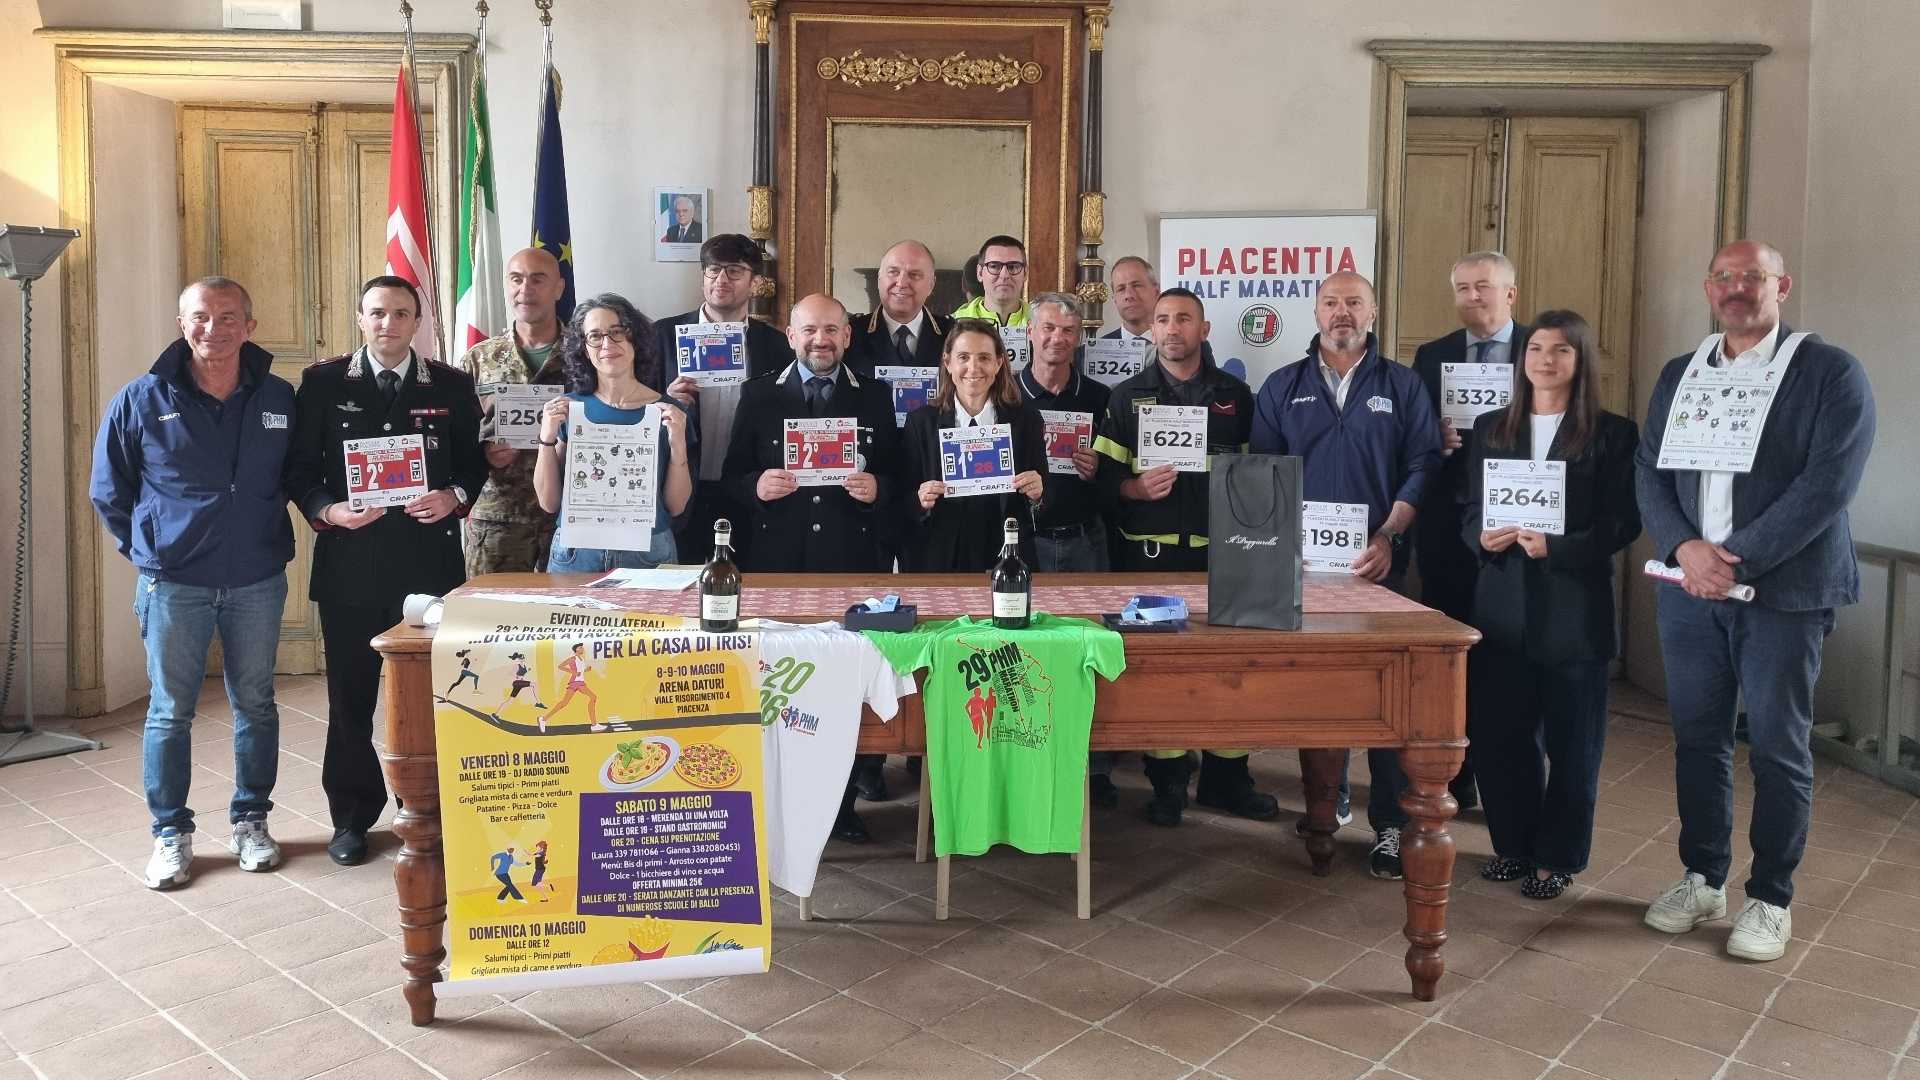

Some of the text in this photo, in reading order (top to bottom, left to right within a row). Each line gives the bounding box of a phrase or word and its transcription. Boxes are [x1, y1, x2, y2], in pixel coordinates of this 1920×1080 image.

[1178, 246, 1357, 275] PLACENTIA
[1096, 360, 1133, 376] 324
[1457, 388, 1497, 406] 332
[158, 412, 181, 422] CRAFT
[273, 414, 288, 426] PHM
[1153, 430, 1193, 448] 622
[980, 483, 1006, 491] CRAFT
[389, 494, 416, 502] CRAFT
[1499, 487, 1549, 507] 264
[1523, 521, 1552, 529] CRAFT
[1310, 528, 1350, 548] 198
[550, 612, 665, 629] EVENTI COLLATERALI
[593, 634, 752, 659] PER LA CASA DI IRIS!
[987, 641, 1023, 674] PHM
[656, 662, 725, 679] 8-9-10 MAGGIO
[761, 656, 816, 694] 20
[1006, 666, 1022, 687] HALF
[659, 678, 725, 694] ARENA DATURI
[999, 669, 1020, 713] MARATHON
[654, 690, 730, 705] VIALE RISORGIMENTO 4
[677, 703, 710, 714] PIACENZA
[799, 712, 820, 732] PHM
[460, 750, 566, 771] VENERDÌ 8 MAGGIO
[459, 765, 570, 782] DALLE ORE 19 DJ RADIO SOUND
[471, 779, 560, 792] Salumi tipici Primi piatti
[458, 795, 489, 805] Grigliata
[490, 793, 510, 801] mista
[511, 791, 519, 800] di
[545, 789, 573, 798] verdura
[615, 795, 712, 815] SABATO 9 MAGGIO
[476, 805, 506, 813] Patatine
[537, 801, 558, 809] Dolce
[490, 815, 503, 823] Bar
[509, 812, 546, 822] caffetteria
[600, 816, 621, 827] DALLE
[622, 815, 636, 825] ORE
[651, 812, 684, 823] MERENDA
[685, 811, 692, 820] DI
[693, 810, 708, 820] UNA
[708, 809, 729, 819] VOLTA
[603, 827, 624, 837] DALLE
[625, 826, 639, 836] ORE
[677, 820, 727, 832] GASTRONOMICI
[610, 832, 720, 847] ORE 20 CENA SU PRENOTAZIONE
[591, 851, 613, 860] (Laura
[614, 849, 628, 858] 339
[665, 846, 691, 855] Gianna
[623, 860, 635, 869] Bis
[635, 860, 643, 868] di
[644, 859, 663, 870] primi
[668, 857, 695, 866] Arrosto
[695, 857, 709, 865] con
[709, 855, 733, 866] patate
[609, 867, 725, 881] Dolce bicchiere di vino acqua
[632, 877, 703, 890] OFFERTA MINIMA 25€
[581, 885, 755, 904] DALLE ORE 20 SERATA DANZANTE CON LA PRESENZA
[617, 898, 720, 913] DI NUMEROSE SCUOLE DI BALLO
[469, 920, 586, 940] DOMENICA 10 MAGGIO
[506, 938, 550, 950] DALLE ORE 12
[484, 950, 571, 964] Salumi tipici Primi piatti
[471, 966, 500, 977] Grigliata
[501, 965, 520, 973] mista
[521, 964, 529, 973] di
